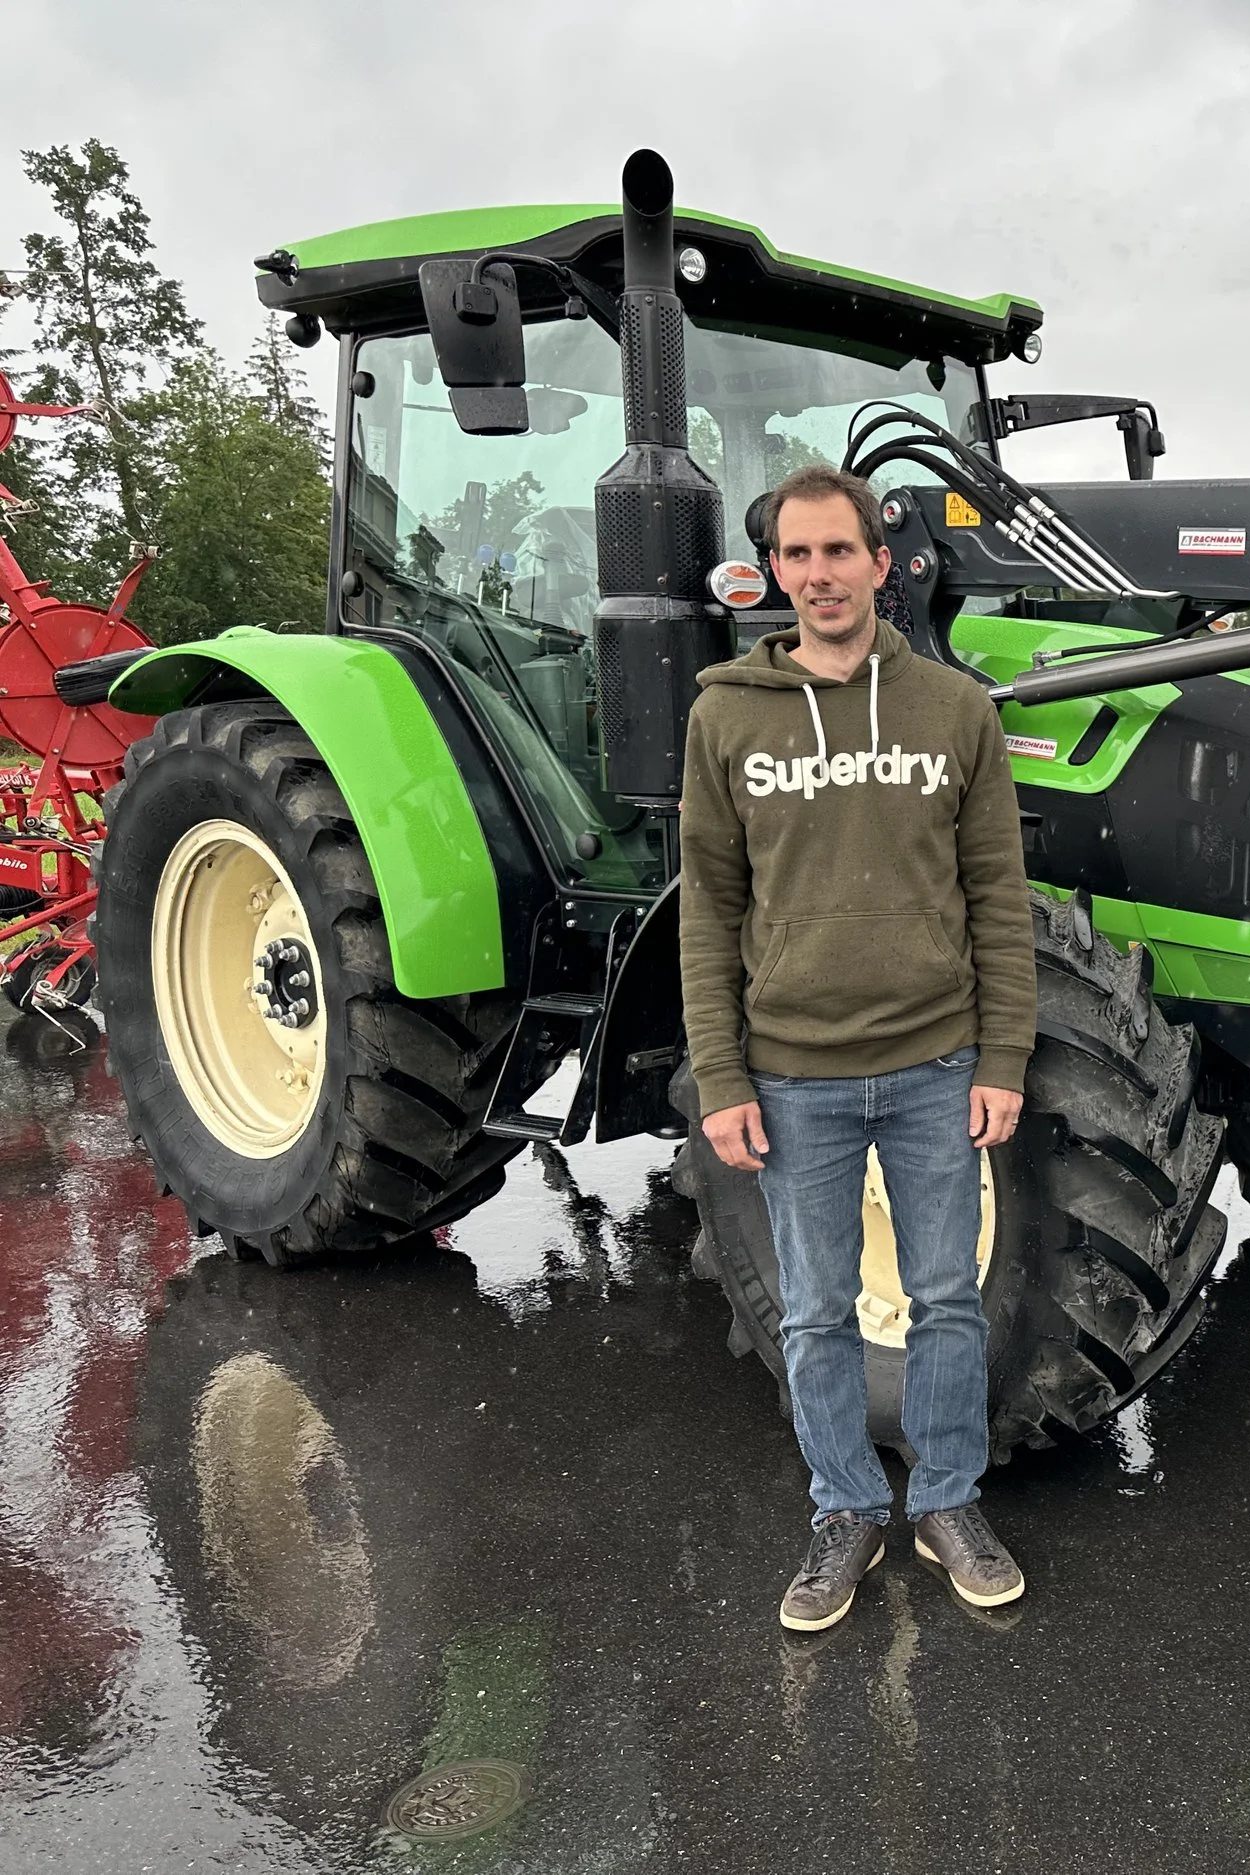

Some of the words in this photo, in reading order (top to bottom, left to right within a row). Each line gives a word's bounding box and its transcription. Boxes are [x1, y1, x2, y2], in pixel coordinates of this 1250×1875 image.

[1193, 535, 1244, 544] BACHMANN
[1014, 739, 1056, 751] BACHMANN
[0, 857, 28, 870] bilo
